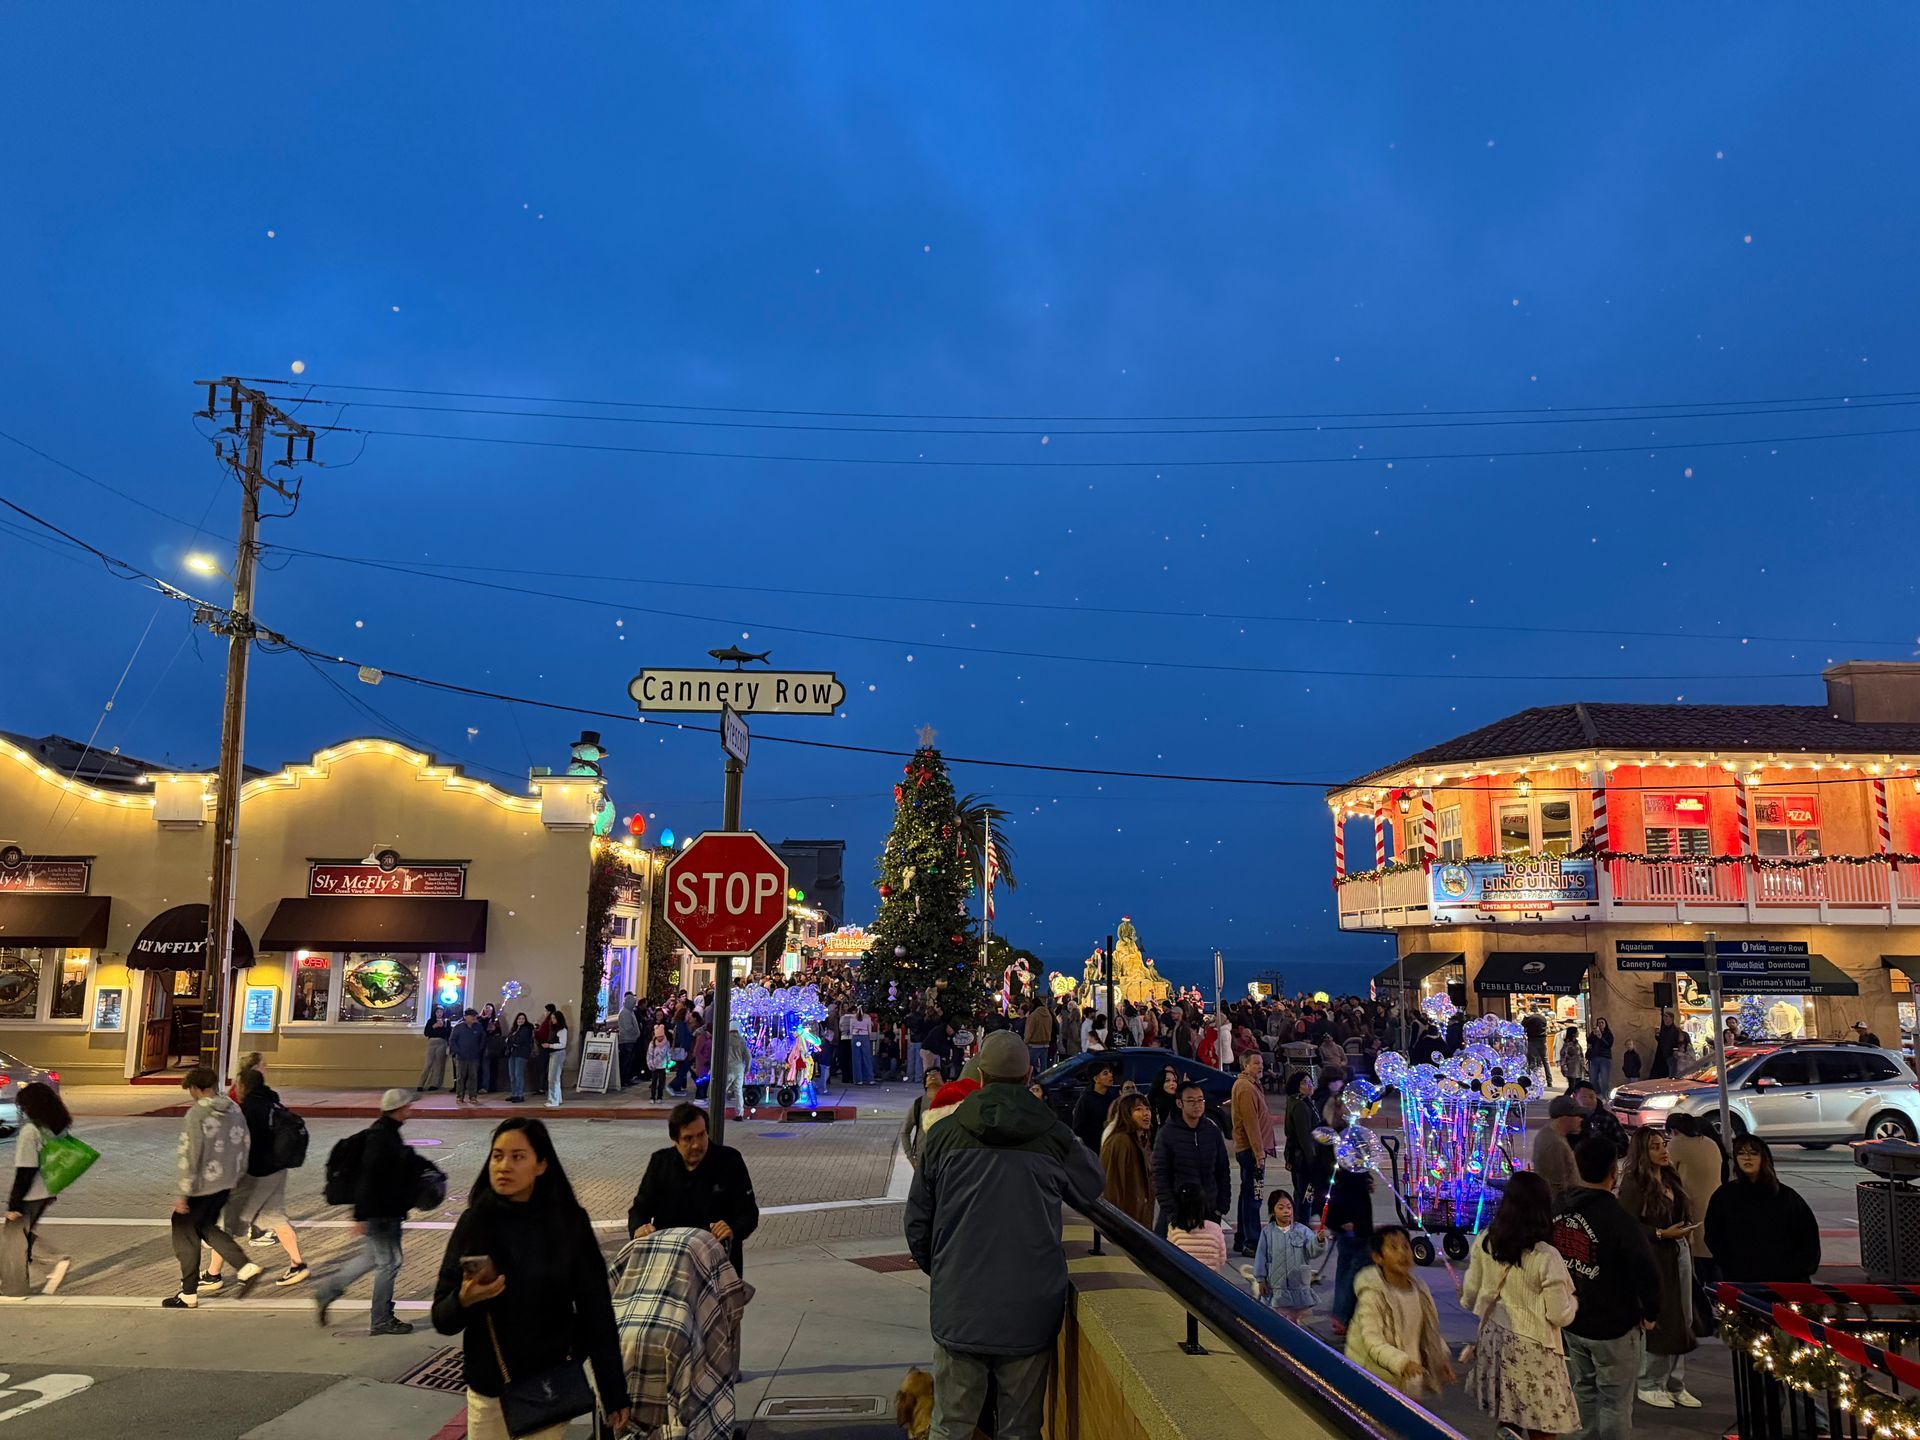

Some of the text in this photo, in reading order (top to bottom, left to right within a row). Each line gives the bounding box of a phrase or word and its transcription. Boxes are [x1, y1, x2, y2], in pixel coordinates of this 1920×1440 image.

[643, 676, 832, 710] Cannery Row
[1786, 810, 1812, 821] PIZZA
[1504, 861, 1560, 875] LOUIE
[314, 875, 400, 891] Sly McFly's
[1482, 875, 1586, 891] LINGUINI'S
[674, 872, 779, 915] STOP
[1482, 891, 1523, 900] SEAFOOD
[1620, 943, 1654, 952] Aquarium
[1749, 943, 1767, 953] Parking
[1788, 944, 1804, 952] Row
[303, 957, 328, 969] OPEN
[1621, 960, 1667, 969] Cannery Row
[1726, 961, 1749, 970] Lighthouse
[1768, 961, 1806, 969] Downtown
[1481, 982, 1571, 993] PEBBLE BEACH OUTLET
[1742, 978, 1784, 987] Fisherman's
